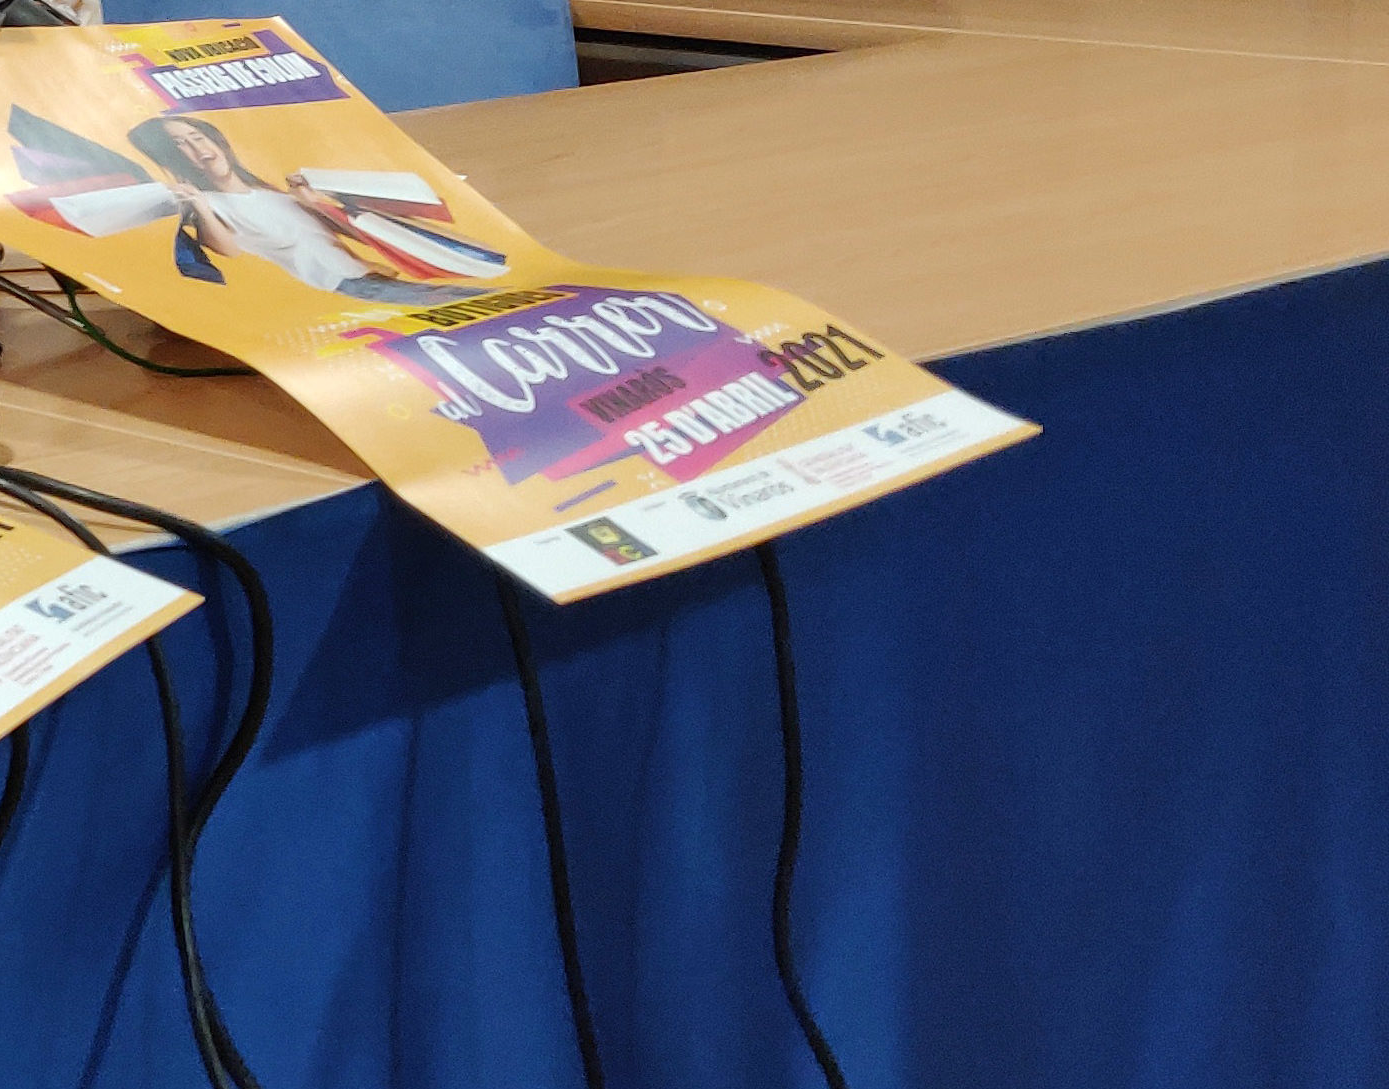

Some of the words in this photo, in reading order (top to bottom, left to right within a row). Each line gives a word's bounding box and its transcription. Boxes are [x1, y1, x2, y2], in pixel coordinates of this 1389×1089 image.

[417, 293, 718, 413] Carrer
[623, 420, 693, 465] 25
[663, 371, 800, 445] D'ABRIL
[758, 323, 885, 392] 2021
